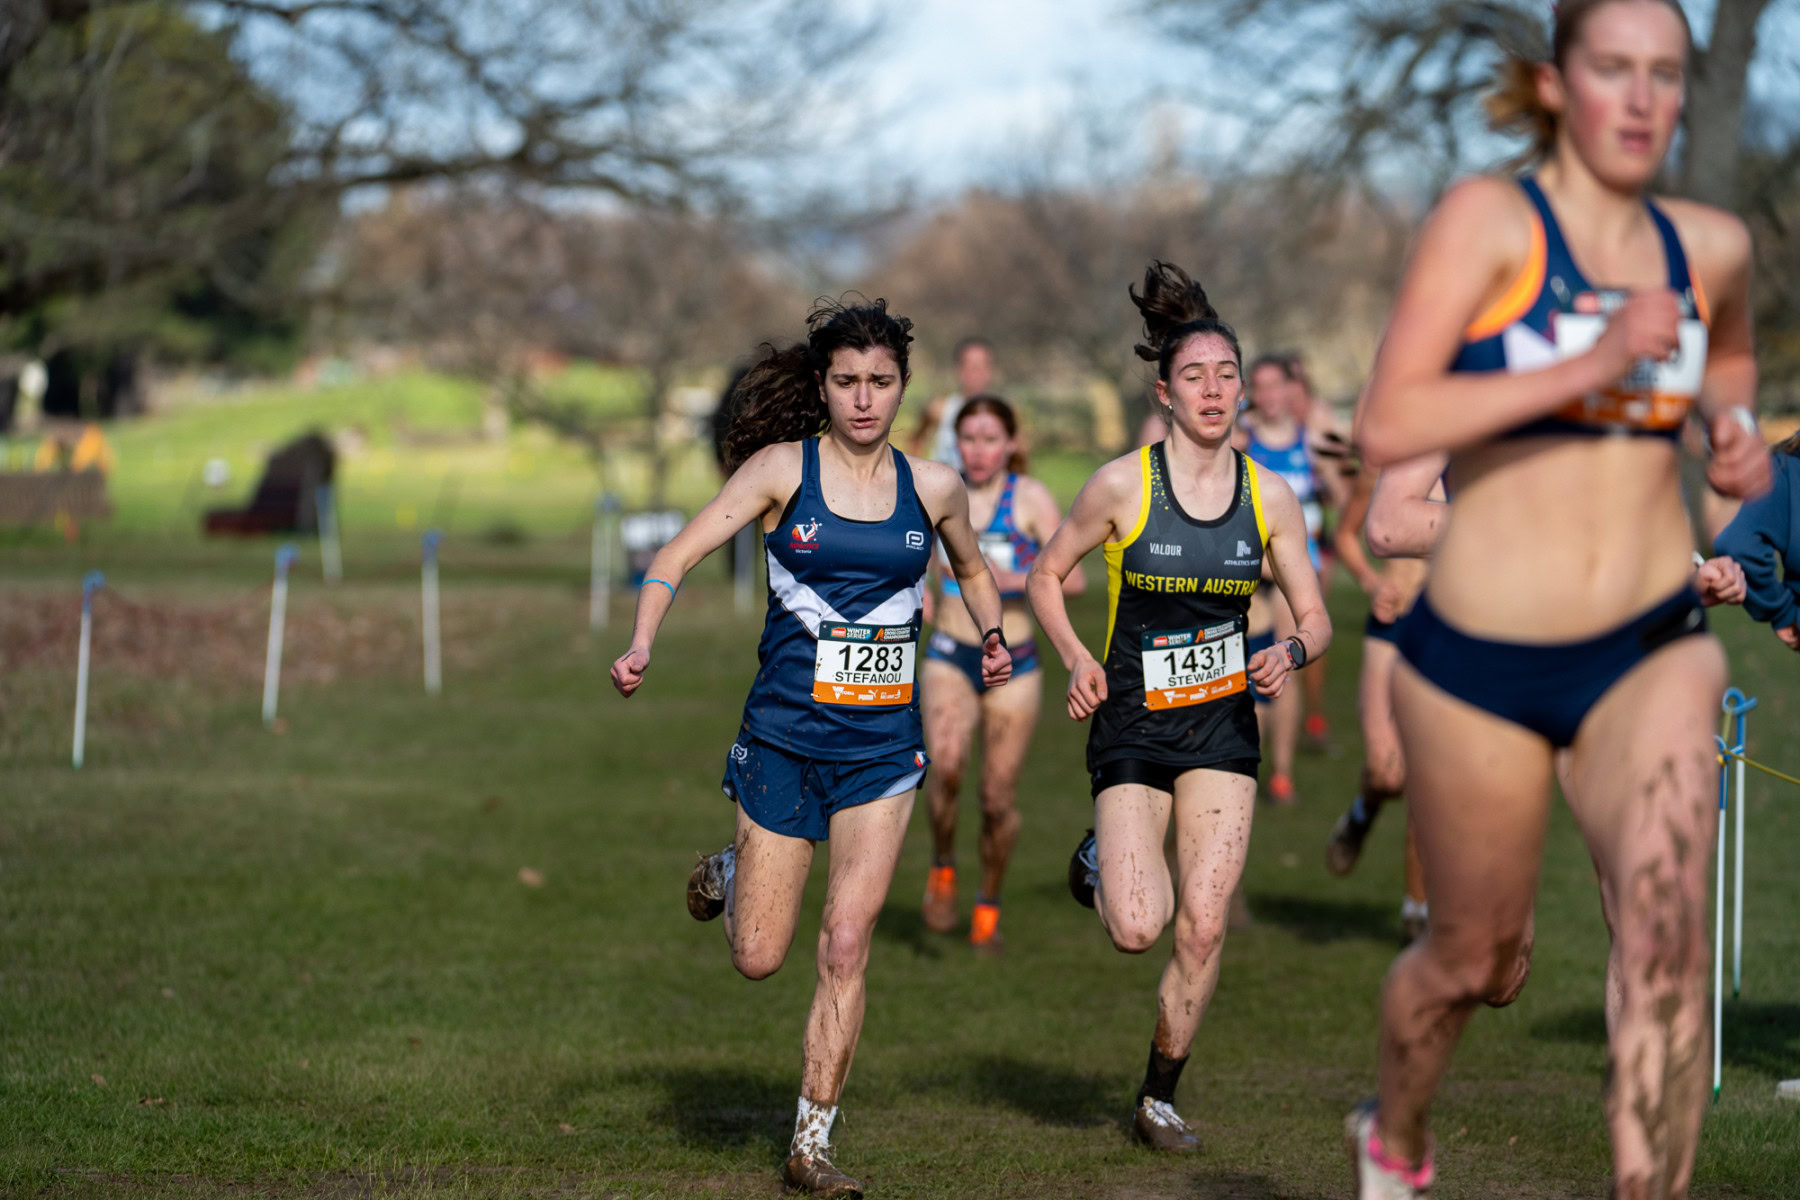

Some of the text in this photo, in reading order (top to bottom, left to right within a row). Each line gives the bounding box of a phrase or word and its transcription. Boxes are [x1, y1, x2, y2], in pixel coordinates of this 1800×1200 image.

[789, 541, 819, 550] Athletics
[1149, 542, 1182, 557] VALOUR
[1125, 570, 1199, 593] WESTERN
[846, 627, 871, 635] WINTER
[1168, 632, 1192, 640] WINTER
[838, 644, 904, 672] 1283
[1163, 639, 1226, 675] 1431
[835, 671, 902, 684] STEFANOU
[1168, 665, 1227, 687] STEWART
